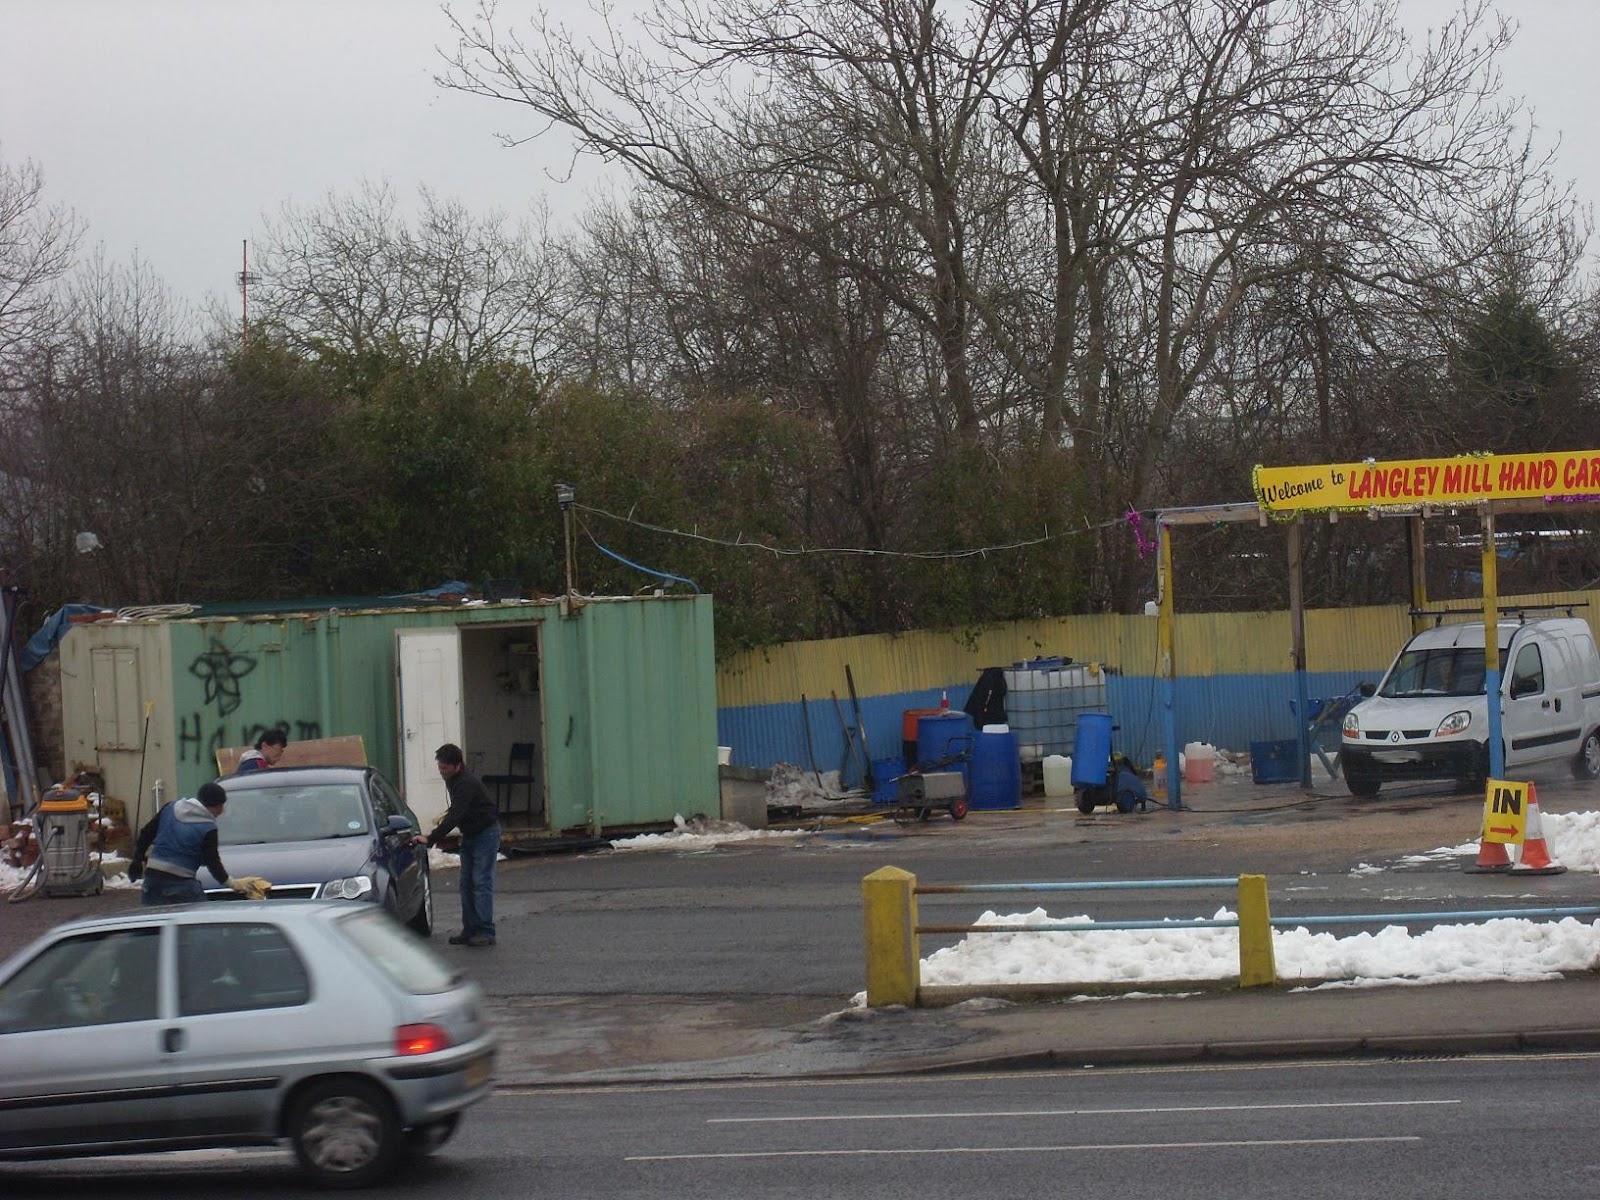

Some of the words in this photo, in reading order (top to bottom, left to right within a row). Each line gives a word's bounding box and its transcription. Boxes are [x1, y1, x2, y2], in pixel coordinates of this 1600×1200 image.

[1261, 478, 1325, 505] Welcome
[1331, 469, 1346, 486] to
[1348, 466, 1440, 499] LANGLEY
[1442, 463, 1493, 495] MILL
[1499, 459, 1558, 491] HAND
[1563, 457, 1600, 489] CAR
[1491, 788, 1522, 815] IN
